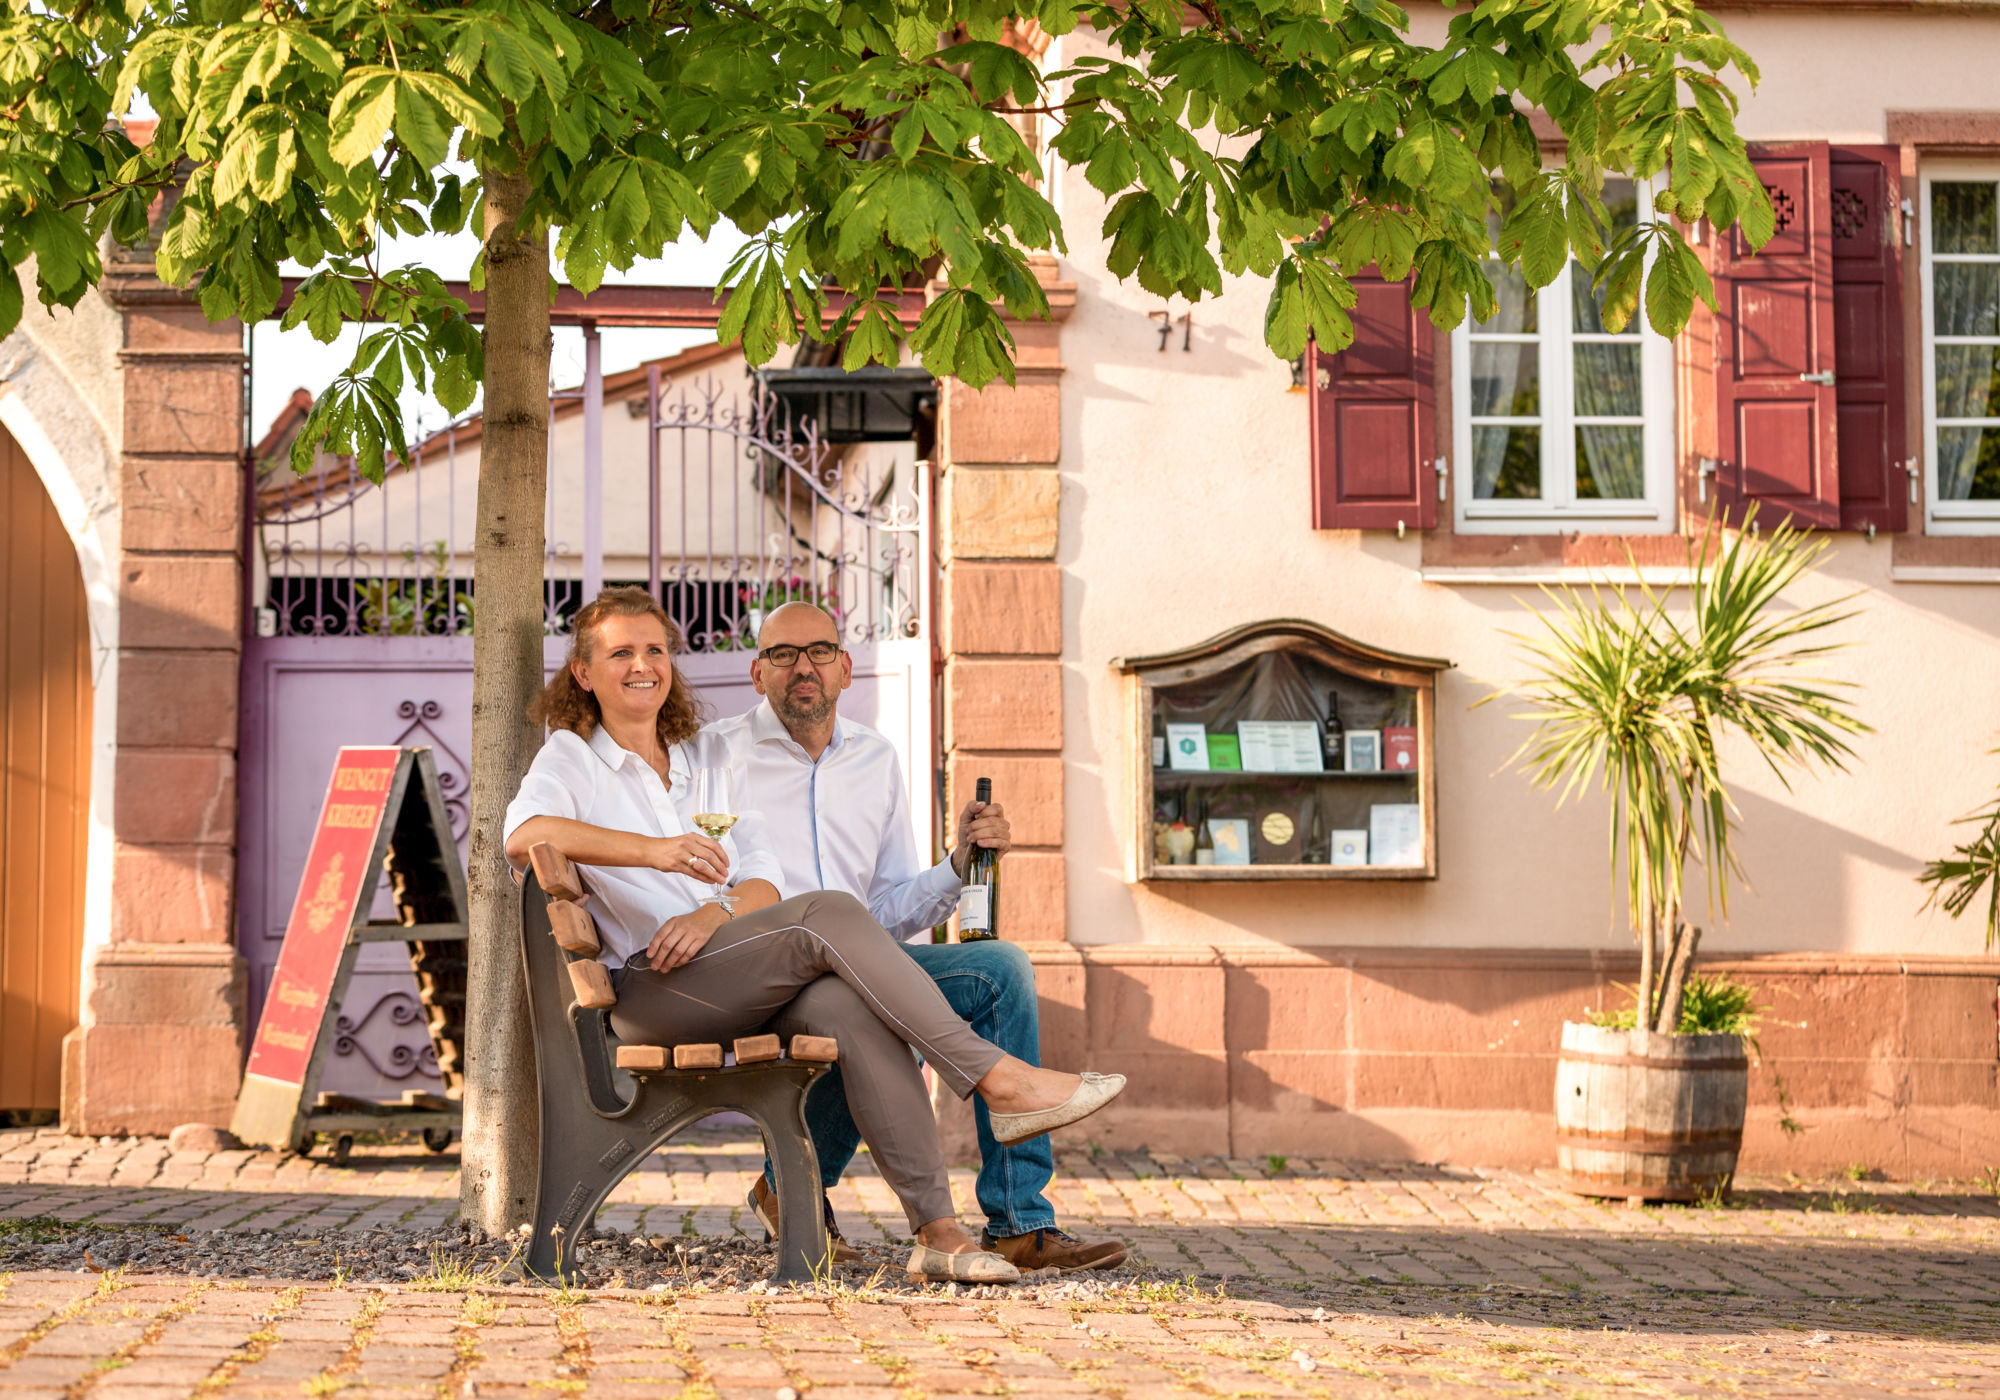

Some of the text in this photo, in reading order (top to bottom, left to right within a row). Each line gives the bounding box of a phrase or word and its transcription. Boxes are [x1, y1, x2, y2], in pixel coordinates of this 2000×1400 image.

[1148, 310, 1191, 353] 71
[335, 767, 391, 792] WEINGUT
[324, 803, 377, 829] KRIEGER
